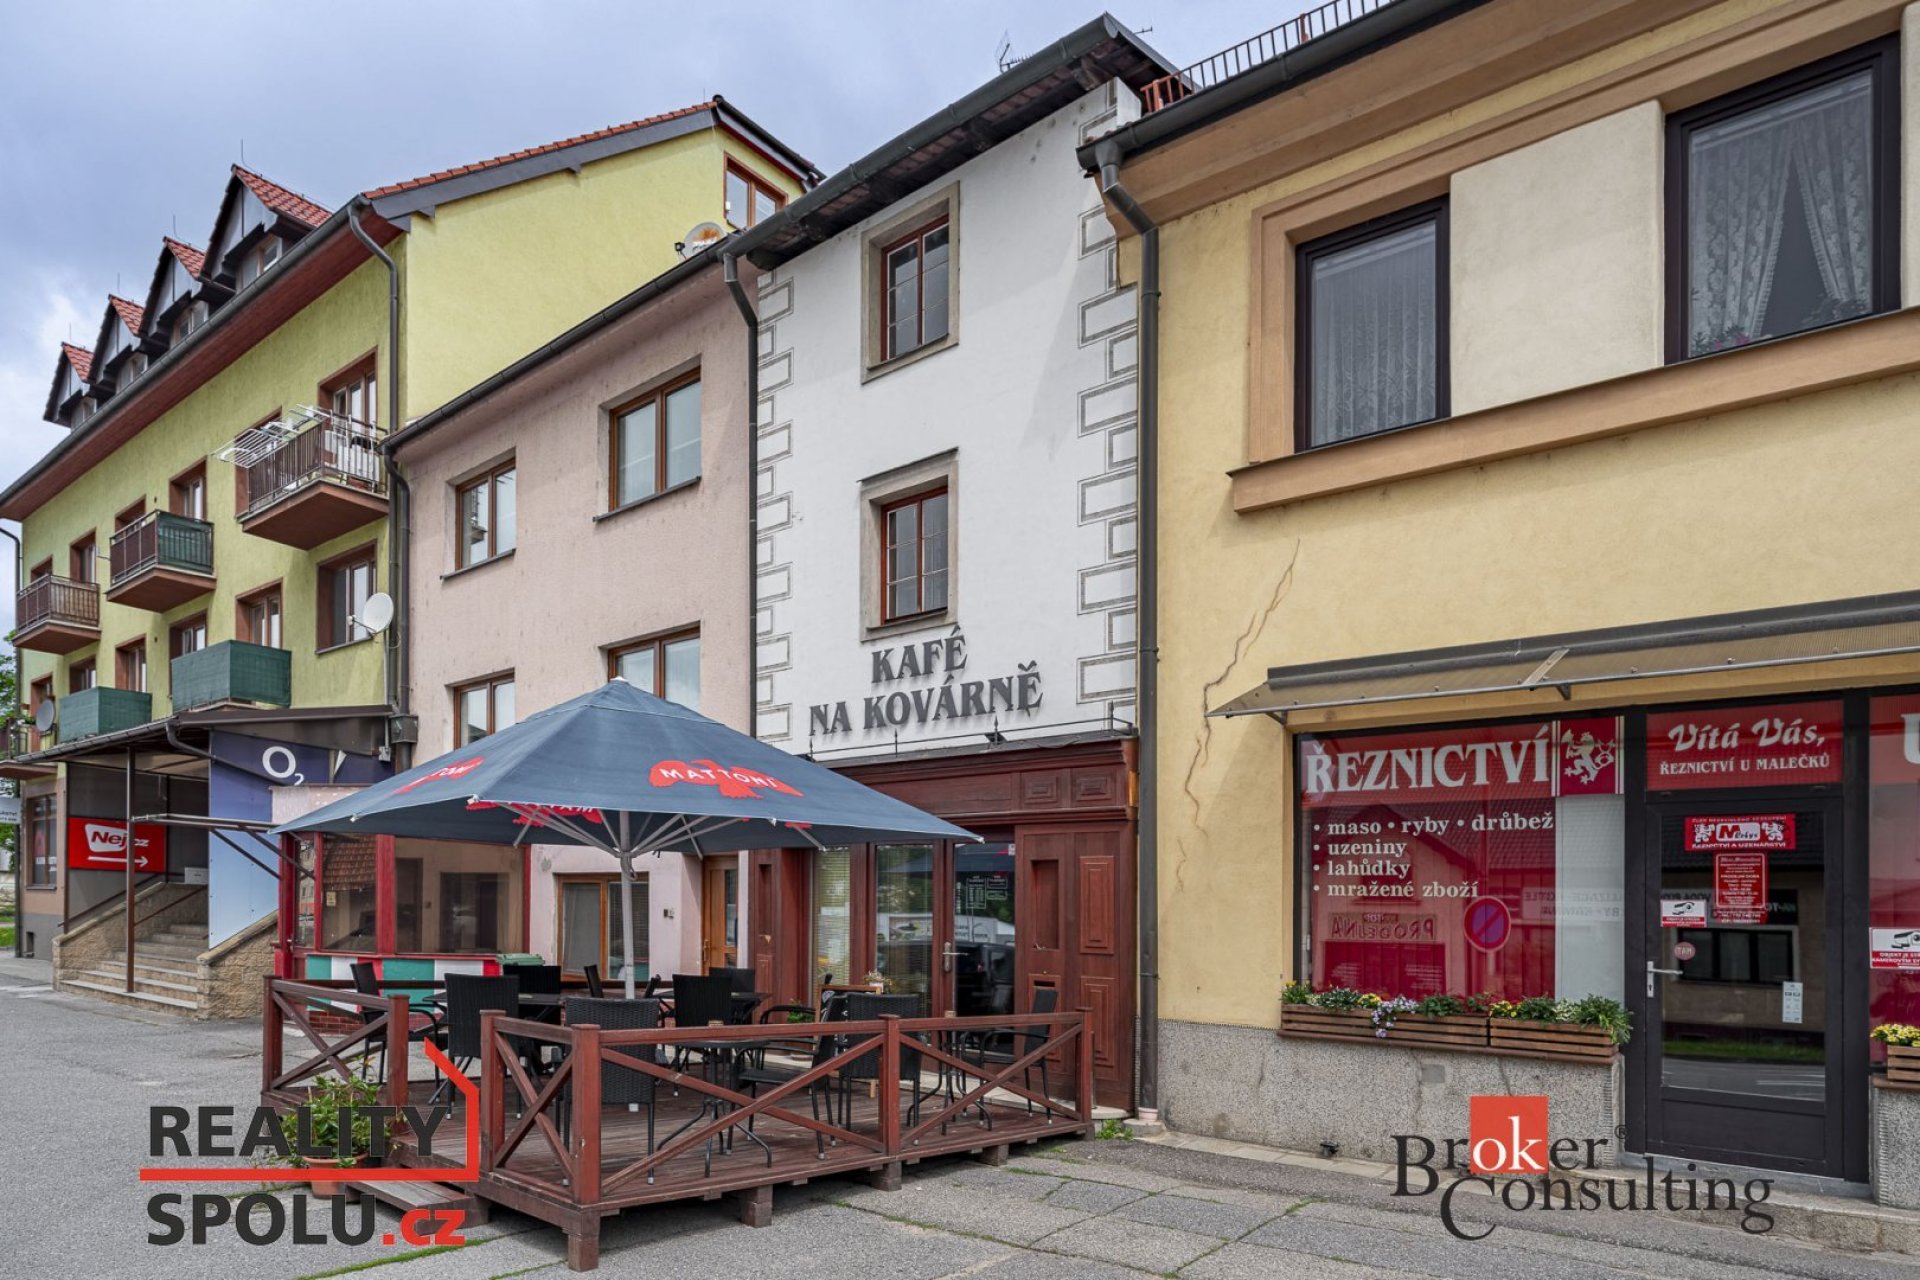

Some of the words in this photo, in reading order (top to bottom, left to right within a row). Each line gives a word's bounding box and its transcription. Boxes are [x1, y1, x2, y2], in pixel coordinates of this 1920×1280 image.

[871, 624, 968, 683] KAFÉ
[808, 700, 852, 736] NA
[863, 660, 1043, 729] KOVÁRNĚ
[1668, 722, 1741, 752] Vítá
[1751, 717, 1825, 748] Vás,
[1305, 724, 1549, 794] ŘEZNICTVÍ
[1659, 756, 1734, 775] ŘEZNICTVÍ
[1740, 759, 1750, 772] U
[1756, 751, 1830, 771] MALEČKŮ
[659, 768, 778, 788] MATTONI
[1327, 820, 1382, 835] maso
[1400, 816, 1449, 837] ryby
[1471, 811, 1554, 832] drůbež
[1327, 840, 1408, 857] uzeniny
[1327, 858, 1411, 878] lahůdky
[1327, 881, 1415, 898] mražené
[1422, 880, 1480, 898] zboží
